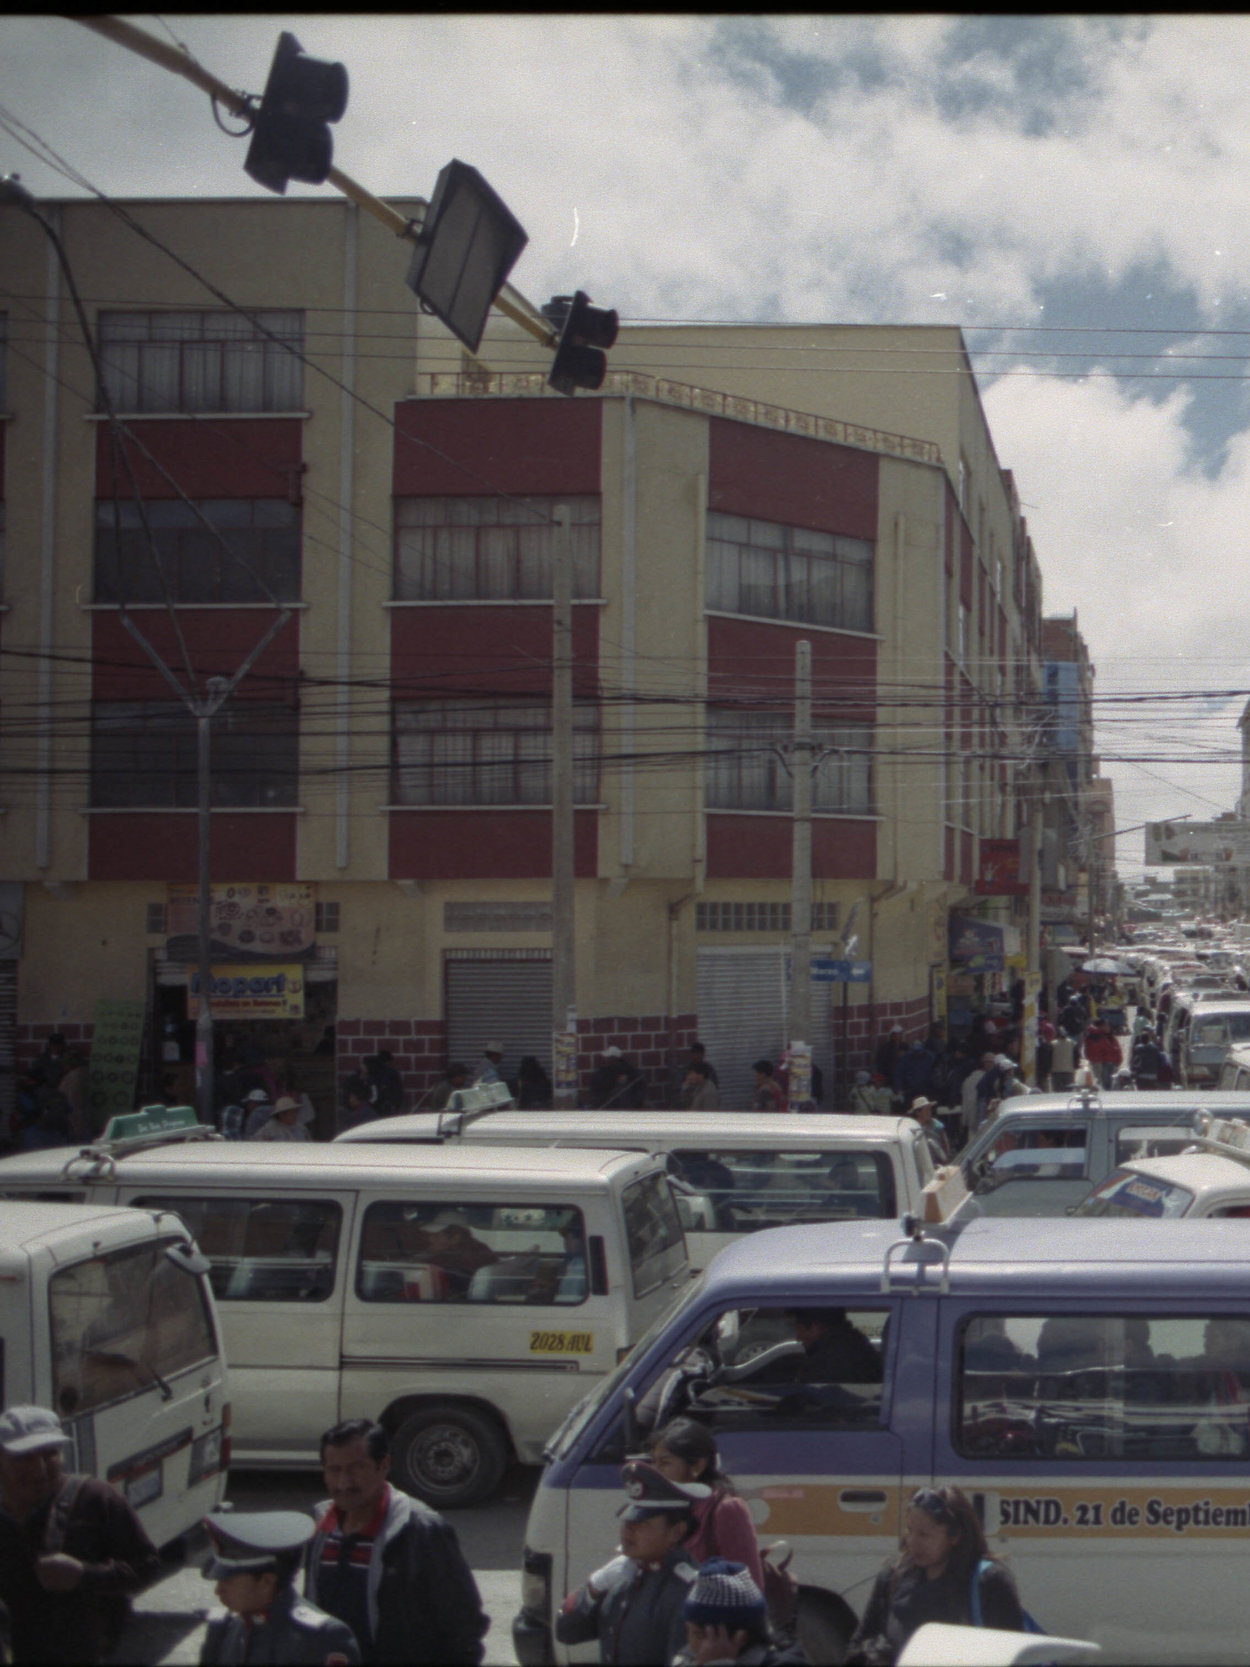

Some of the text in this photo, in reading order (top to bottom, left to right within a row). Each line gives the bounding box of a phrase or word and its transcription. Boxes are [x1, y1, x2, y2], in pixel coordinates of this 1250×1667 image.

[999, 1499, 1069, 1526] SIND.
[1075, 1501, 1103, 1526] 21
[1110, 1500, 1140, 1527] de
